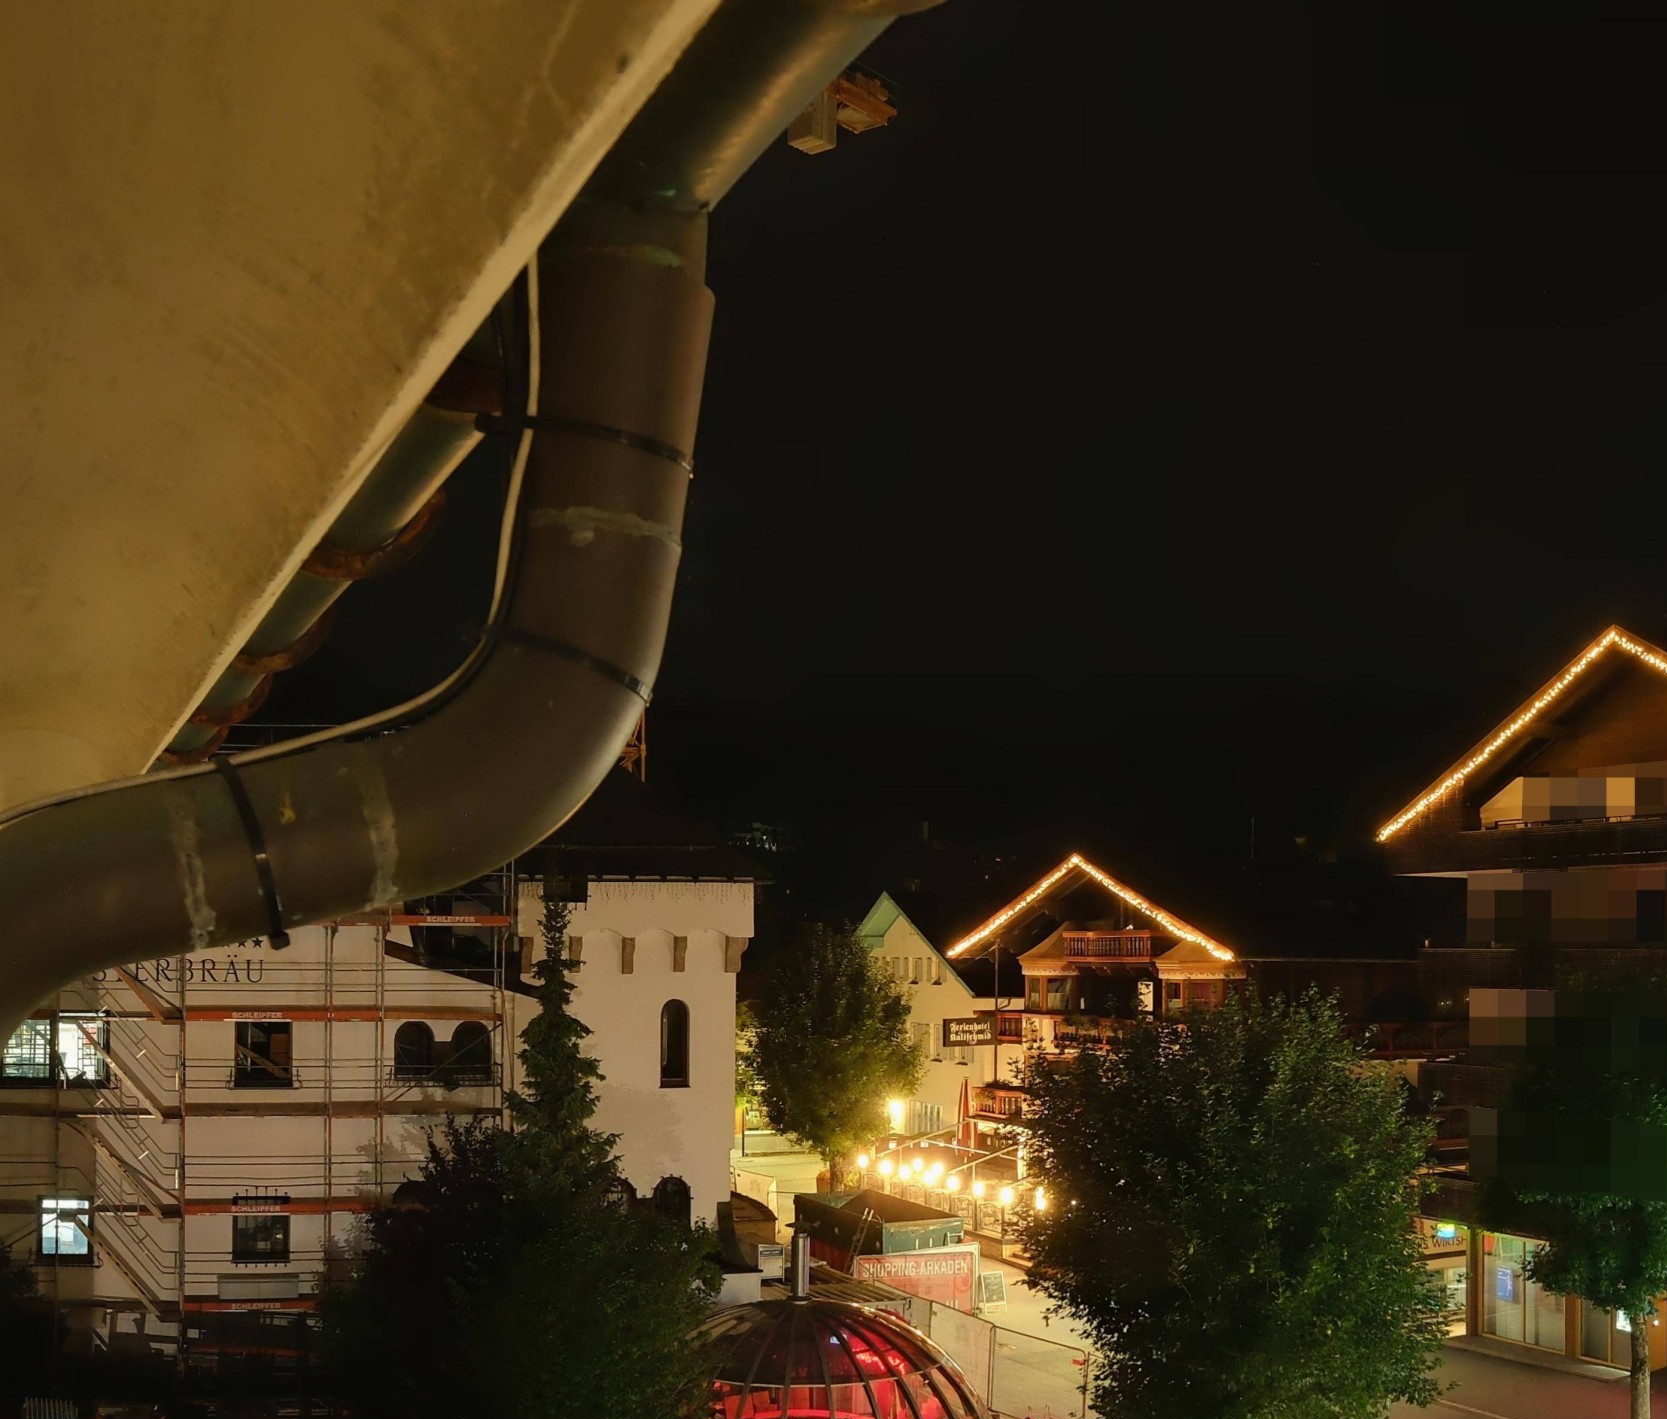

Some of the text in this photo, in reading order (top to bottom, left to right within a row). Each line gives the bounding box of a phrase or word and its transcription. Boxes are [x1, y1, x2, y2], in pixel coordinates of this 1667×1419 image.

[426, 915, 476, 924] SCHLEIPFER
[93, 953, 264, 984] STERBRÄU
[231, 1011, 283, 1019] SCHLEIPFER
[231, 1205, 282, 1213] SCHLEIPFER
[862, 1258, 969, 1279] SHOPPING-ARKADEN
[230, 1302, 282, 1311] SCHLEIPFER
